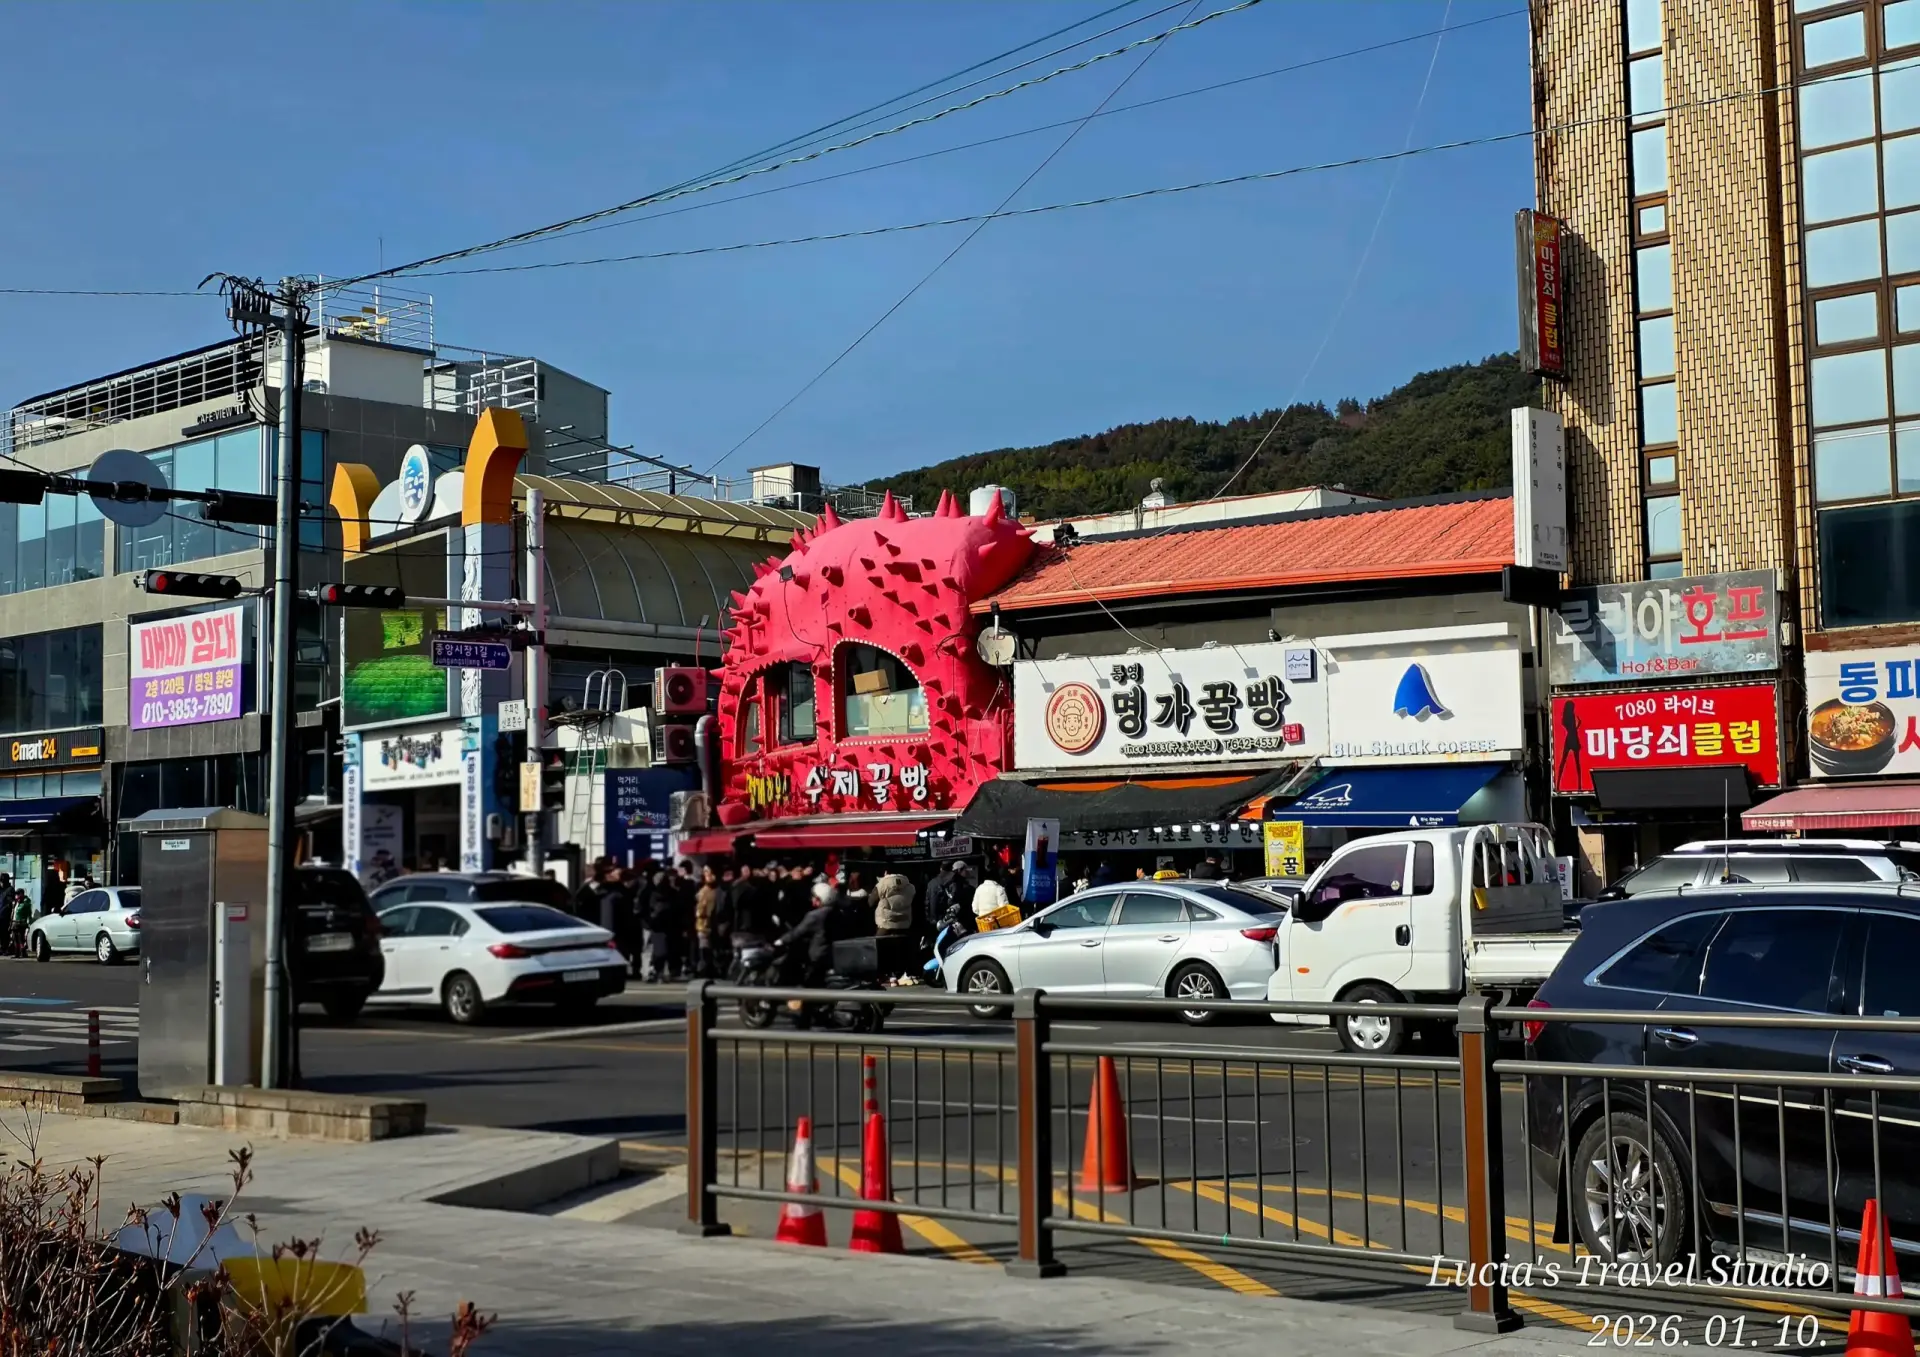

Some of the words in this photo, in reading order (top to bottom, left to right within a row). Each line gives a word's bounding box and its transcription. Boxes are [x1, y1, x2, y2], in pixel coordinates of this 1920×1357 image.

[140, 623, 187, 670] 매매
[191, 613, 236, 664] 임대
[435, 643, 488, 658] 중앙시장1길
[1110, 663, 1141, 682] 통영
[1622, 657, 1699, 674] Hof&Bar
[1745, 653, 1766, 664] 2F
[141, 692, 233, 723] 010-3853-7890
[1615, 698, 1657, 721] 7080
[1663, 695, 1716, 716] 라이브
[11, 738, 56, 762] emart24
[1120, 746, 1144, 756] since
[1334, 743, 1363, 757] Blu
[1281, 857, 1299, 874] 꿀
